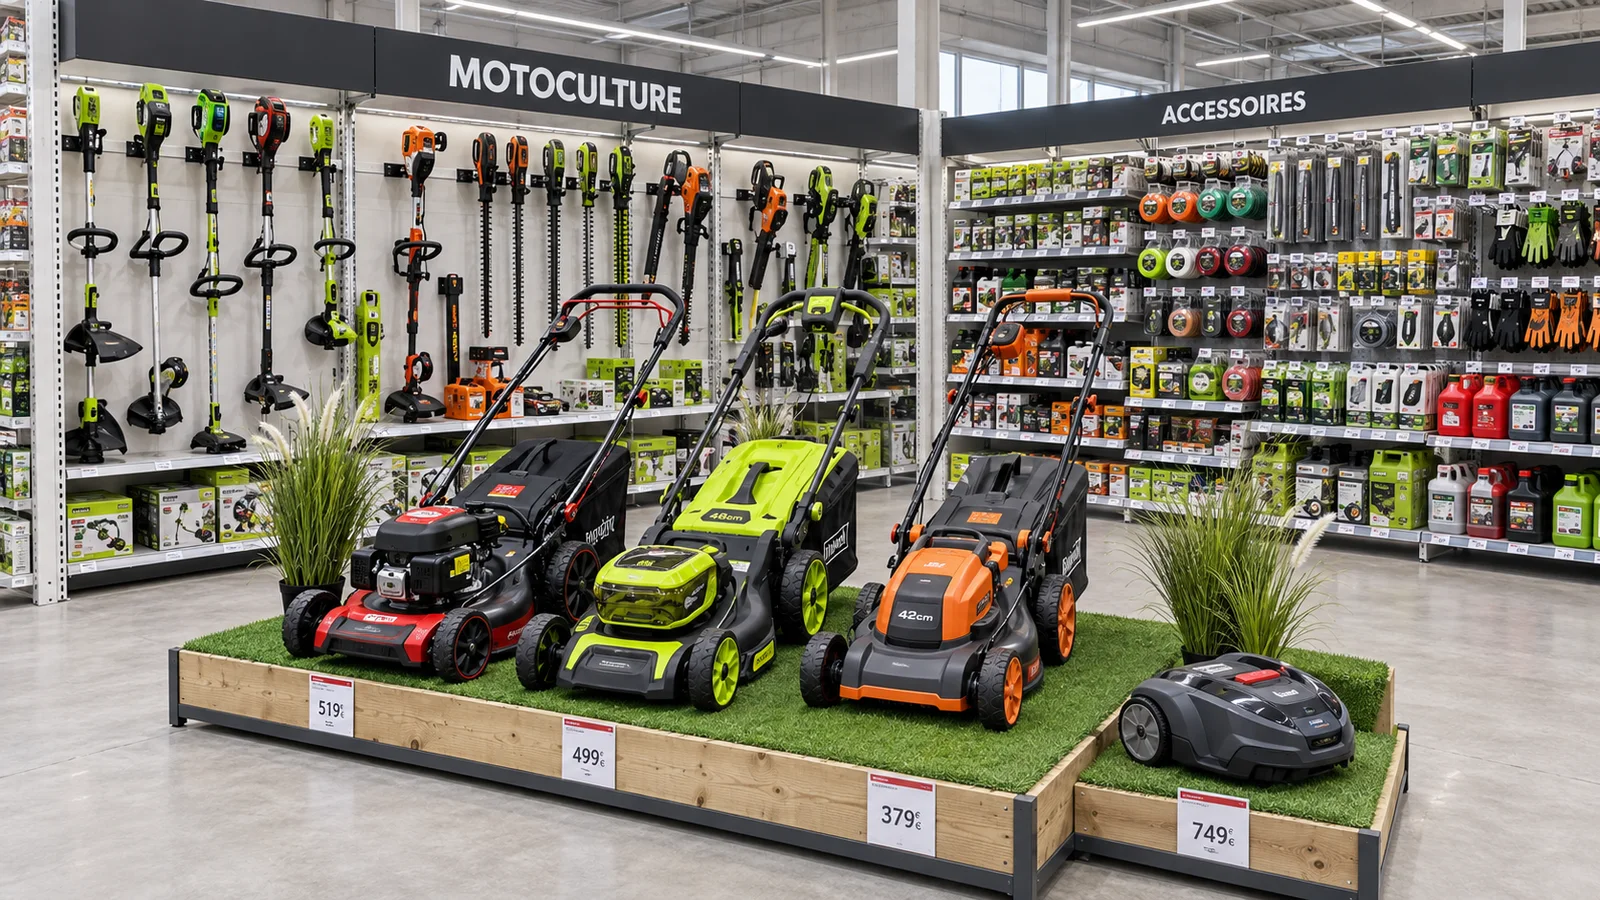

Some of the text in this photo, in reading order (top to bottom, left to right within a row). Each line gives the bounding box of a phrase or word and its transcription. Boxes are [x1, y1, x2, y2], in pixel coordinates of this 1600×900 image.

[449, 54, 682, 115] MOTOCULTURE
[1161, 90, 1307, 125] ACCESSOIRES
[898, 610, 933, 622] 42cm
